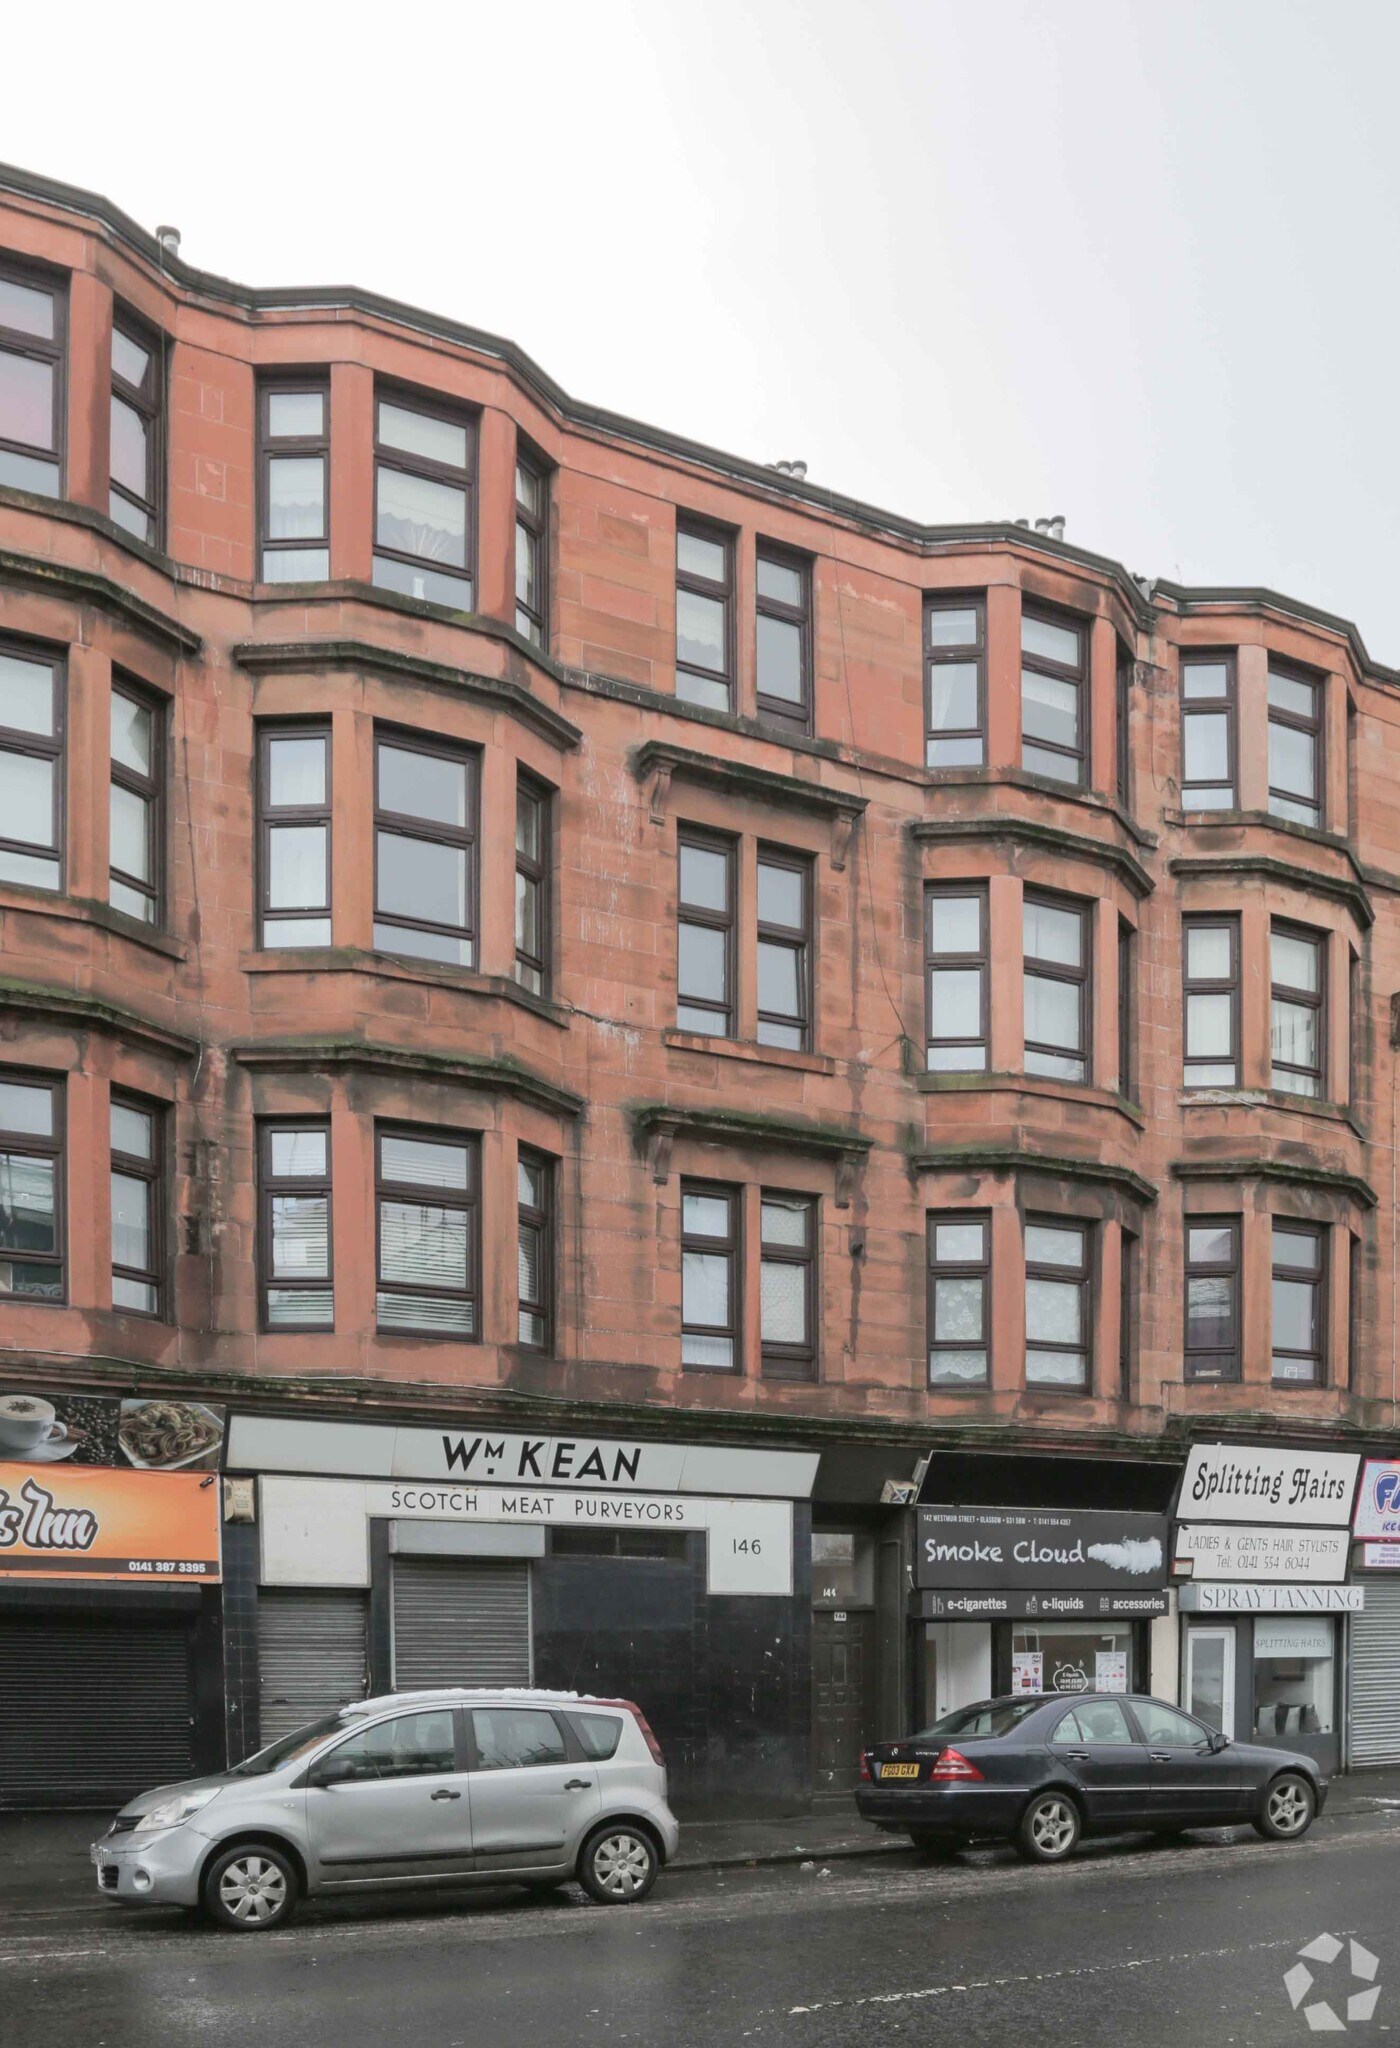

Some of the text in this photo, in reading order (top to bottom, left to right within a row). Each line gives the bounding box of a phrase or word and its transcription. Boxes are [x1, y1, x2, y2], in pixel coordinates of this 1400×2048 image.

[517, 1441, 641, 1482] KEAN
[1192, 1462, 1345, 1504] Splitting Hairs
[21, 1479, 98, 1549] Inn
[391, 1490, 685, 1521] SCOTCH MEAT PURVEYORS
[958, 1515, 975, 1523] STREET
[980, 1516, 1001, 1524] GLASGOW
[731, 1538, 761, 1555] 146
[925, 1538, 1085, 1563] Smoke Cloud
[1188, 1536, 1339, 1553] LADIES & GENTS HAIR STYLISTS
[128, 1561, 206, 1573] 0141 387 3395
[1237, 1555, 1257, 1569] 0141
[1264, 1556, 1279, 1569] 554
[1284, 1556, 1310, 1570] 6044
[823, 1587, 836, 1597] 144
[1202, 1588, 1360, 1609] SPRAY TANNING
[947, 1597, 1165, 1611] e-cigarettes e-liquids accessories
[1256, 1639, 1326, 1648] SPLITTING HAIRS
